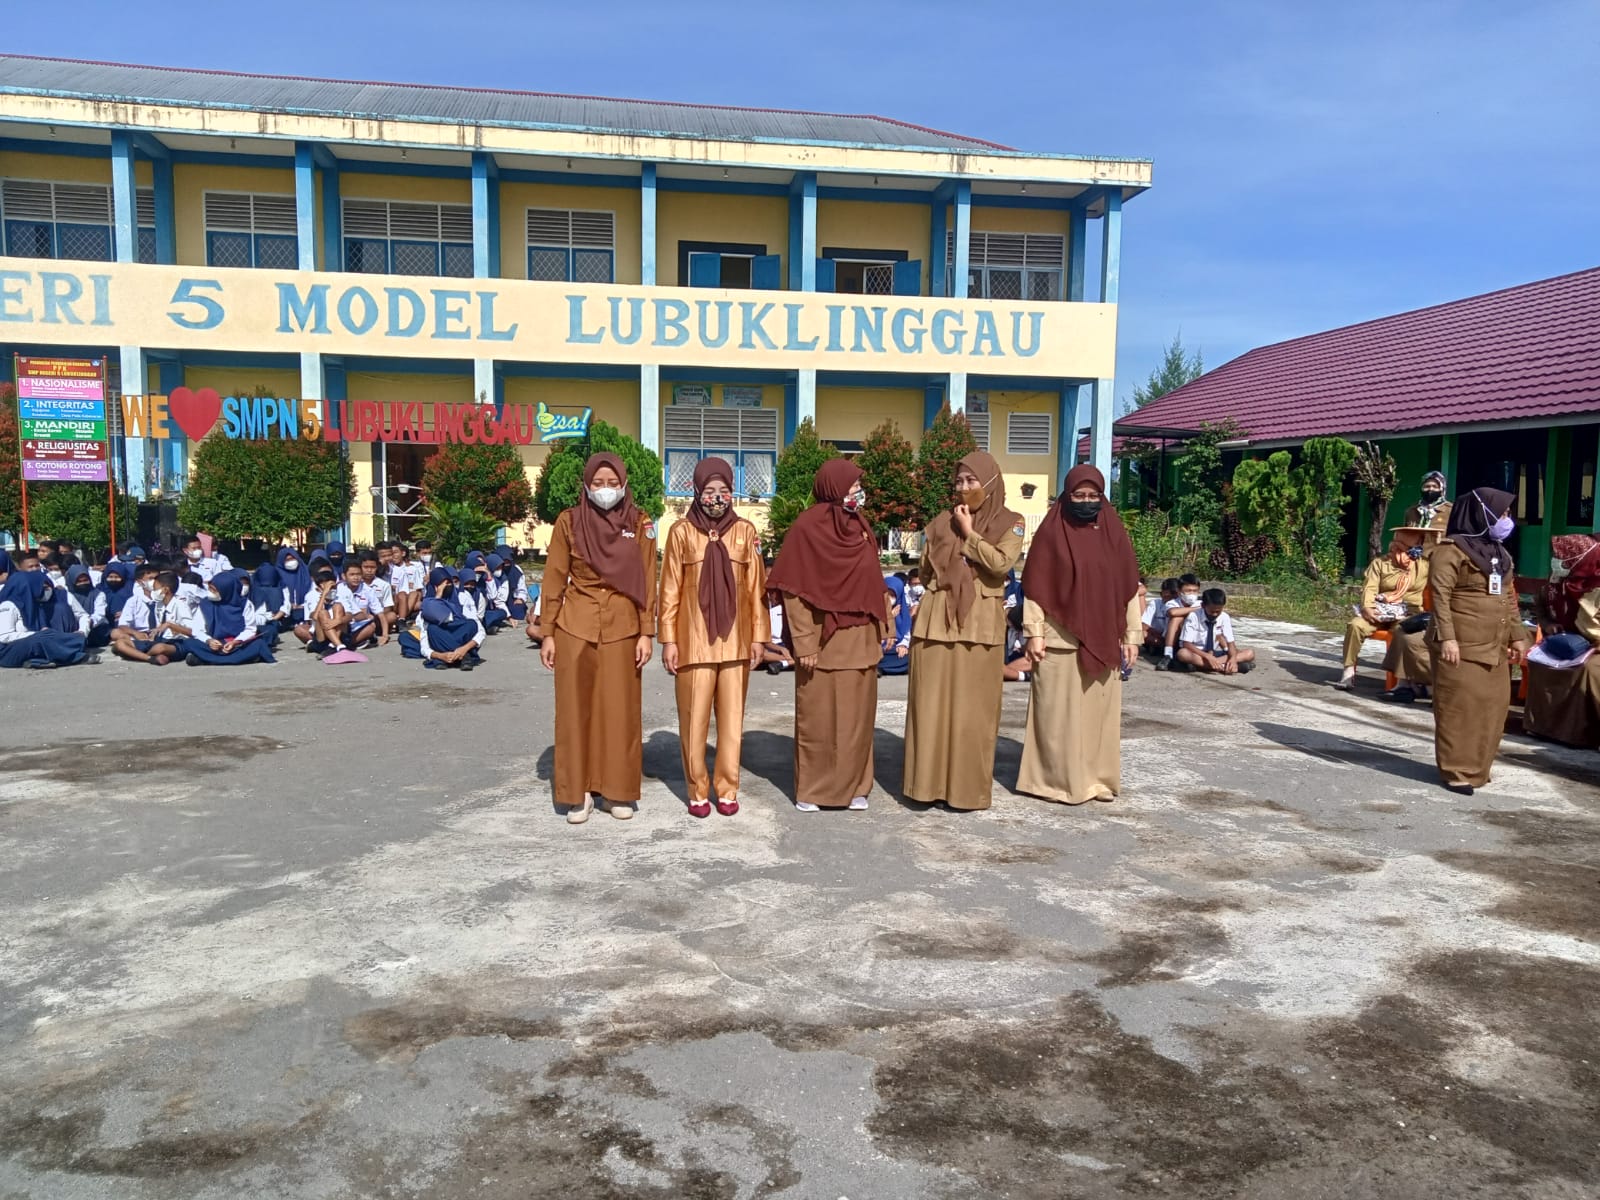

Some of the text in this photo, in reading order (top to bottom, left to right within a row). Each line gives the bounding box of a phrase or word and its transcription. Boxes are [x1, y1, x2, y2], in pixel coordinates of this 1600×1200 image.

[0, 270, 1045, 357] ERI 5 MODEL LUBUKLINGGAU
[31, 379, 100, 389] NASIONALISME
[23, 400, 95, 410] 2. INTEGRITAS
[24, 420, 95, 430] 3. MANDIRI
[121, 395, 169, 439] WE
[222, 397, 298, 441] SMPN
[302, 399, 321, 441] 5
[323, 399, 533, 445] LUBUKLINGGAU
[25, 441, 100, 451] 4. RELIGIUSITAS
